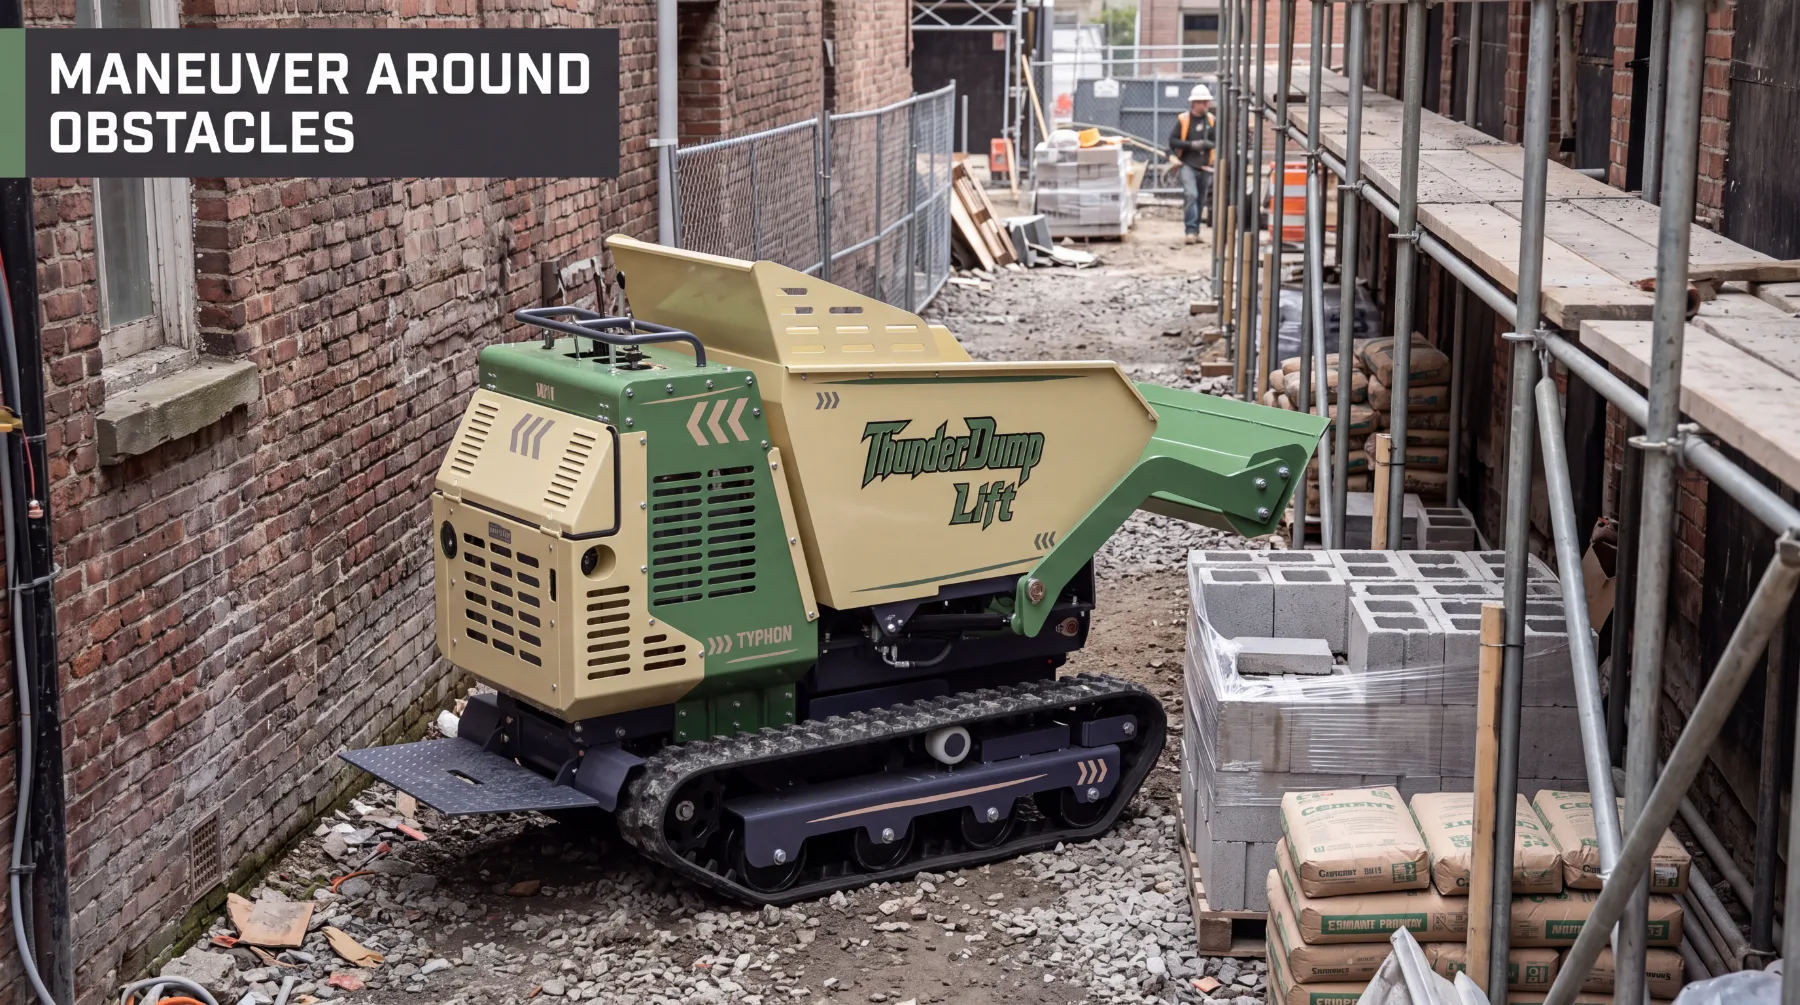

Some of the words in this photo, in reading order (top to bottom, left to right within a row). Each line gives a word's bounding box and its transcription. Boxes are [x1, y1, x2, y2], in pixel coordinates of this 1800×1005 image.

[861, 416, 1045, 490] ThunderDump
[949, 480, 1017, 531] Lift
[736, 624, 793, 649] TYPHON
